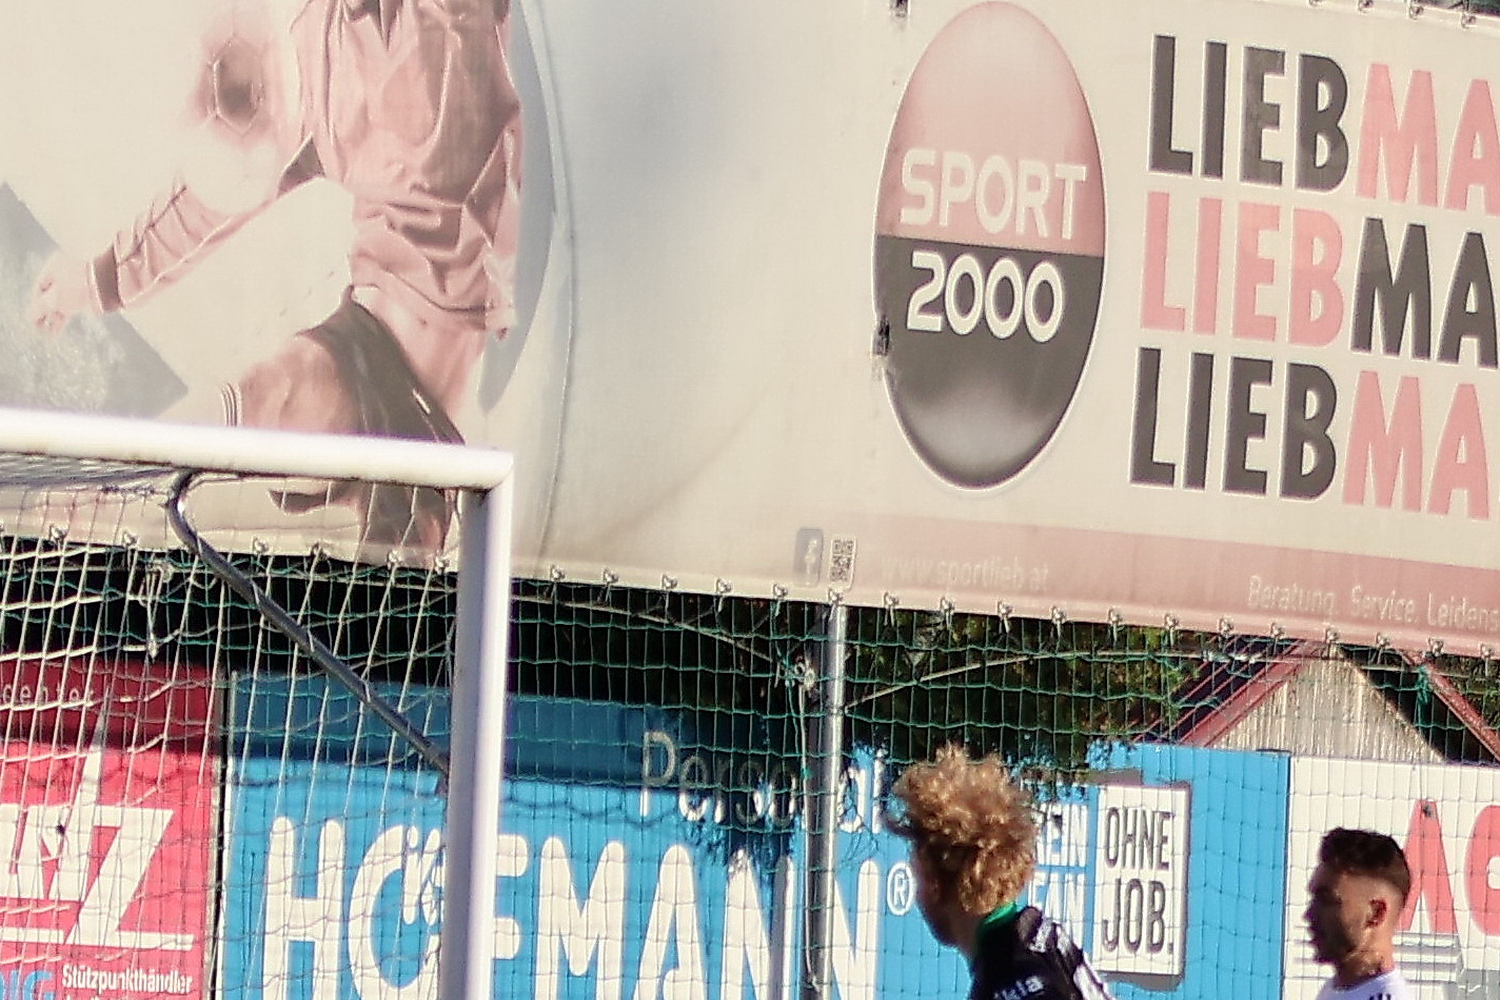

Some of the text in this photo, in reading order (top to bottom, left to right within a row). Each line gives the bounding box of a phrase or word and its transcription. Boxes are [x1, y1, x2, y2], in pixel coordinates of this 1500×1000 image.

[1148, 34, 1500, 216] LIEBMA
[900, 148, 1088, 240] SPORT
[906, 250, 1065, 340] 2000
[1140, 190, 1500, 370] LIEBMA
[1129, 346, 1492, 520] LIEBMA
[639, 728, 885, 834] Persoal
[1104, 807, 1174, 871] OHNE
[1101, 877, 1176, 956] JOB.
[61, 963, 193, 995] Stützpunkthändler
